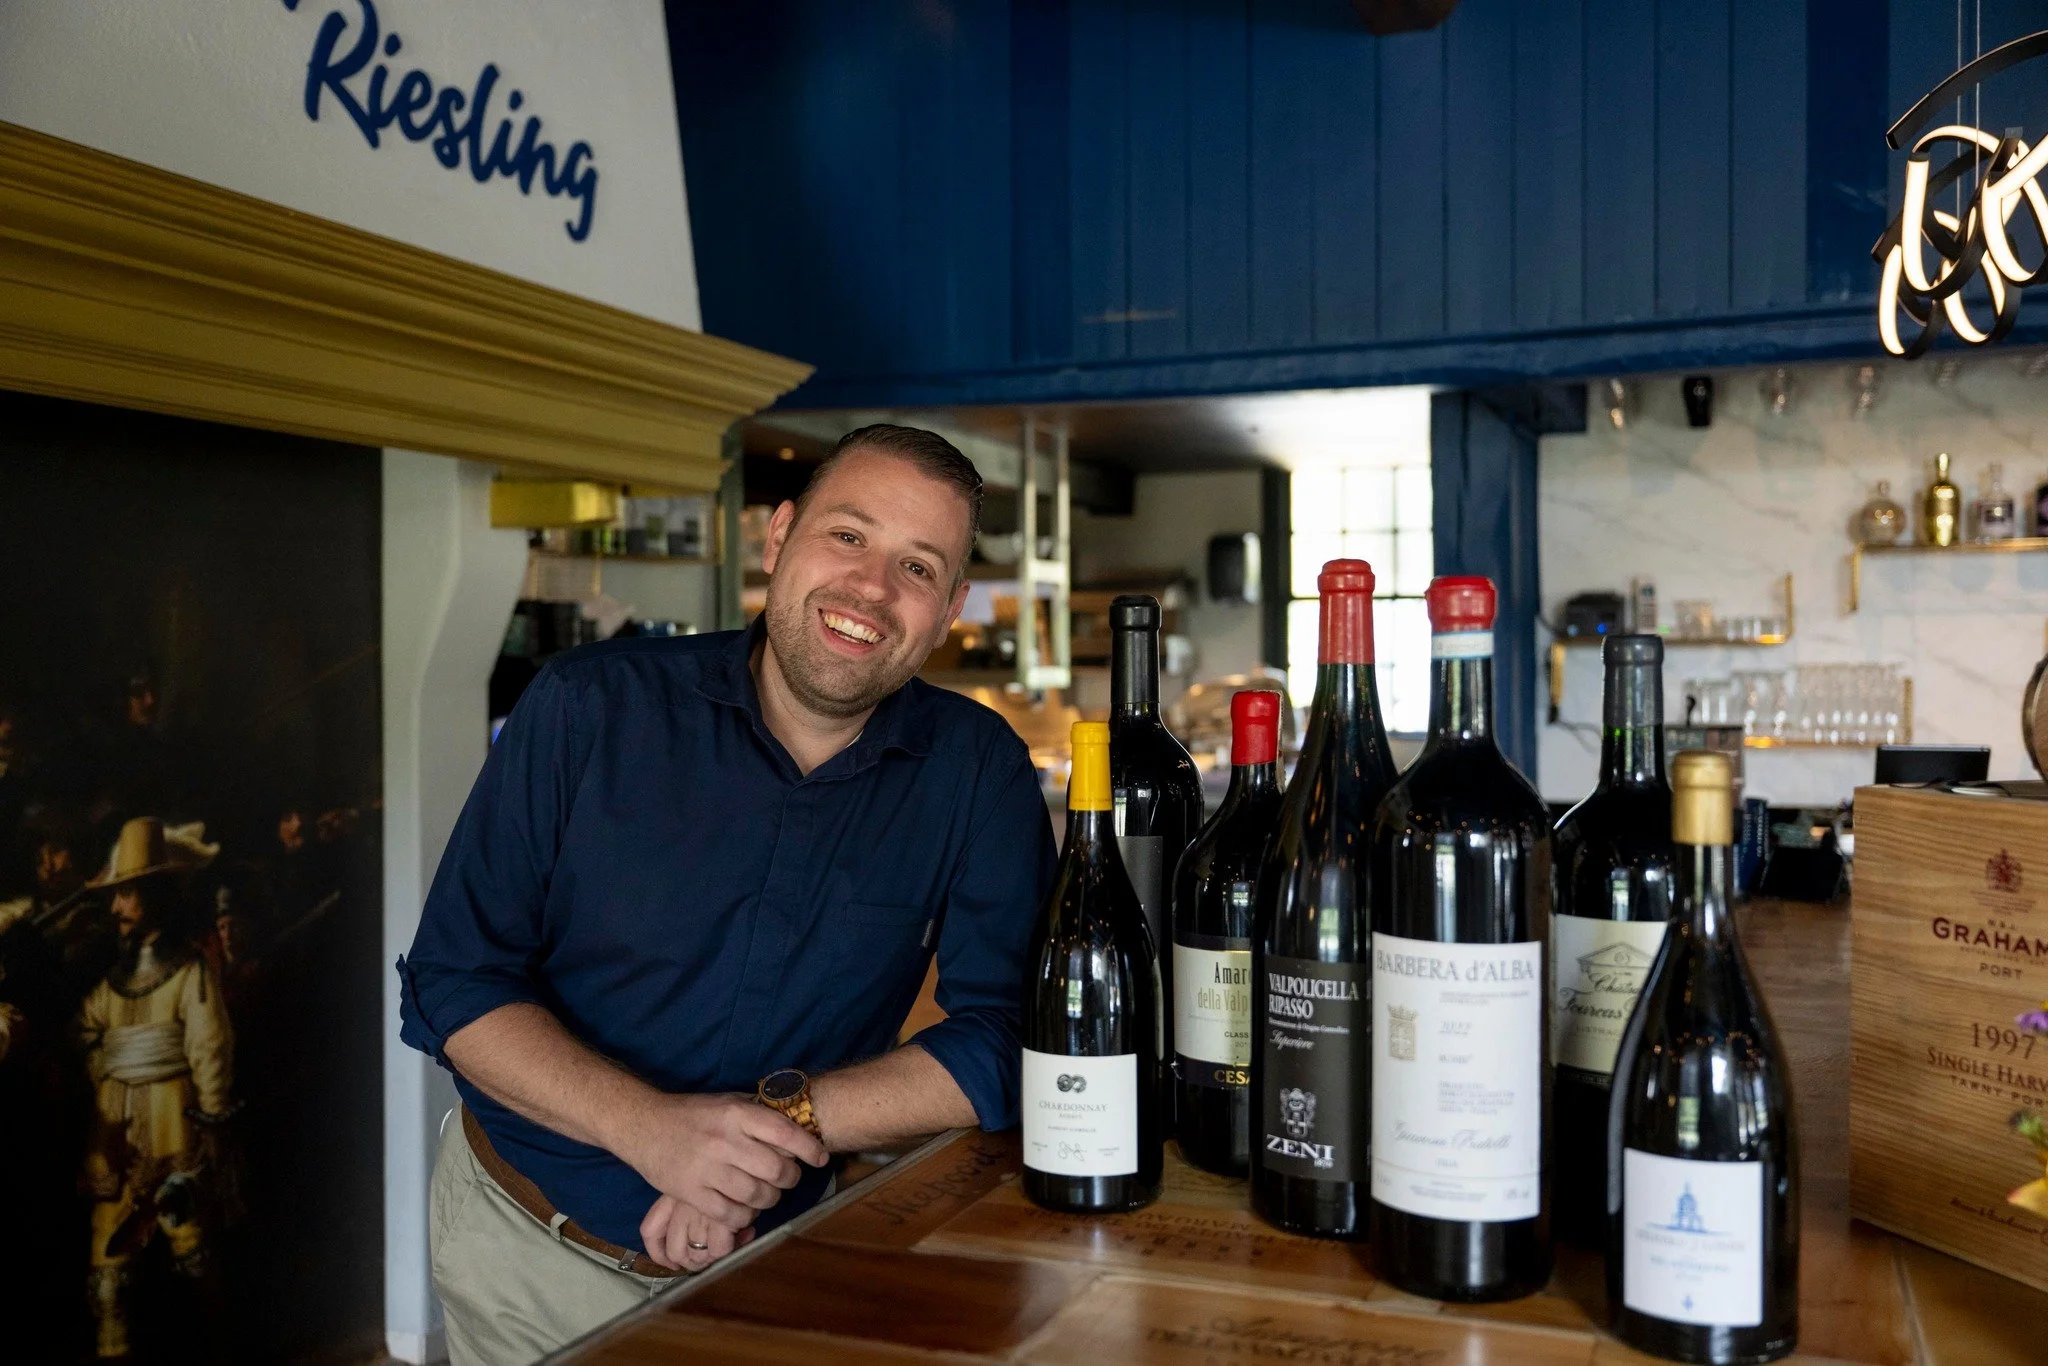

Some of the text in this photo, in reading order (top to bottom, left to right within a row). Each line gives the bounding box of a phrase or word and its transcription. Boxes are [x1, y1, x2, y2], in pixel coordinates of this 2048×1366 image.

[304, 0, 597, 242] Riesling
[1214, 961, 1252, 984] Amar
[1376, 949, 1535, 981] BARBERA d'ALBA
[1979, 962, 2023, 981] PORT
[1269, 973, 1359, 1000] VALPOLICELLA
[1197, 987, 1221, 1011] della
[1269, 994, 1314, 1019] RIPASSO
[1224, 1031, 1249, 1040] CLASS
[1971, 1022, 2036, 1060] 1997
[1951, 1075, 2003, 1096] TAWNY
[1038, 1099, 1109, 1112] CHARDONNAY
[1266, 1134, 1336, 1160] ZENI
